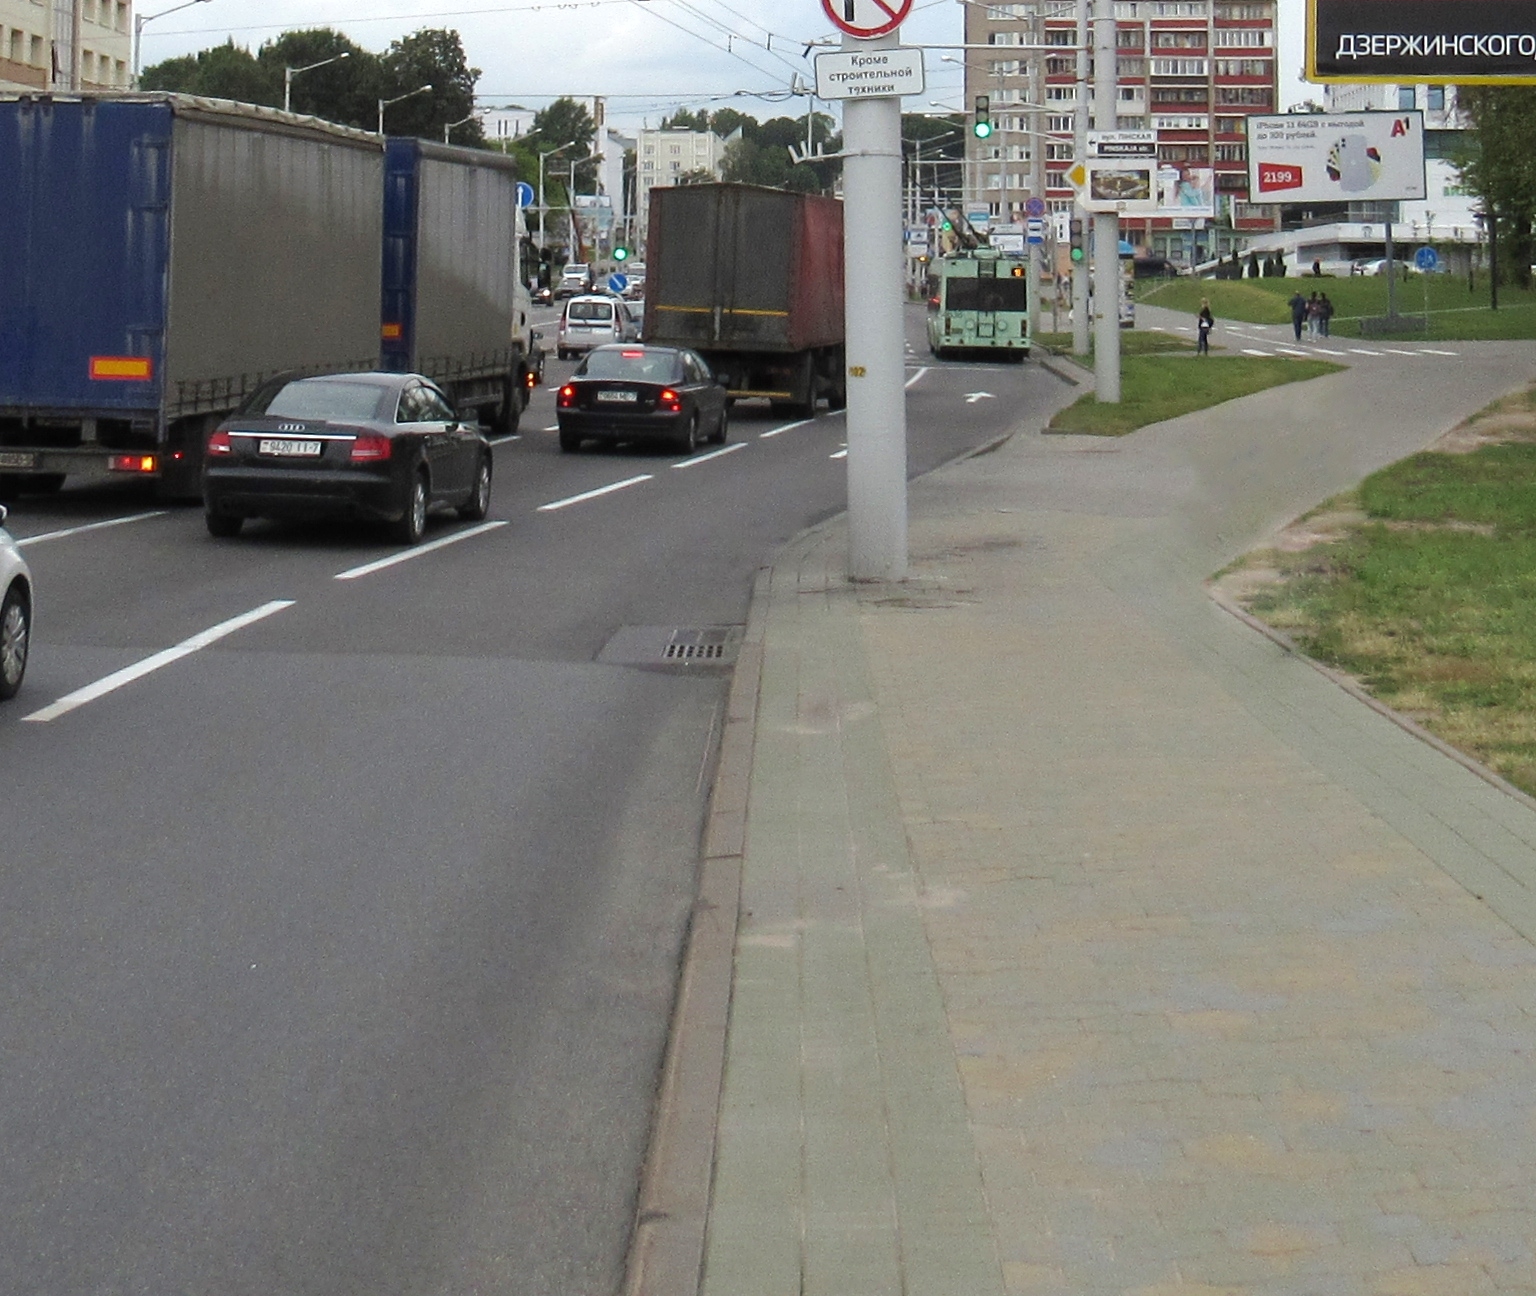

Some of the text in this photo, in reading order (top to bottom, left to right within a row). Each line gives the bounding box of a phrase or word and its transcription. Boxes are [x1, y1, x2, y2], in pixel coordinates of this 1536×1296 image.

[851, 55, 889, 68] Кроме
[829, 66, 913, 83] строительной
[1263, 171, 1292, 183] 2199
